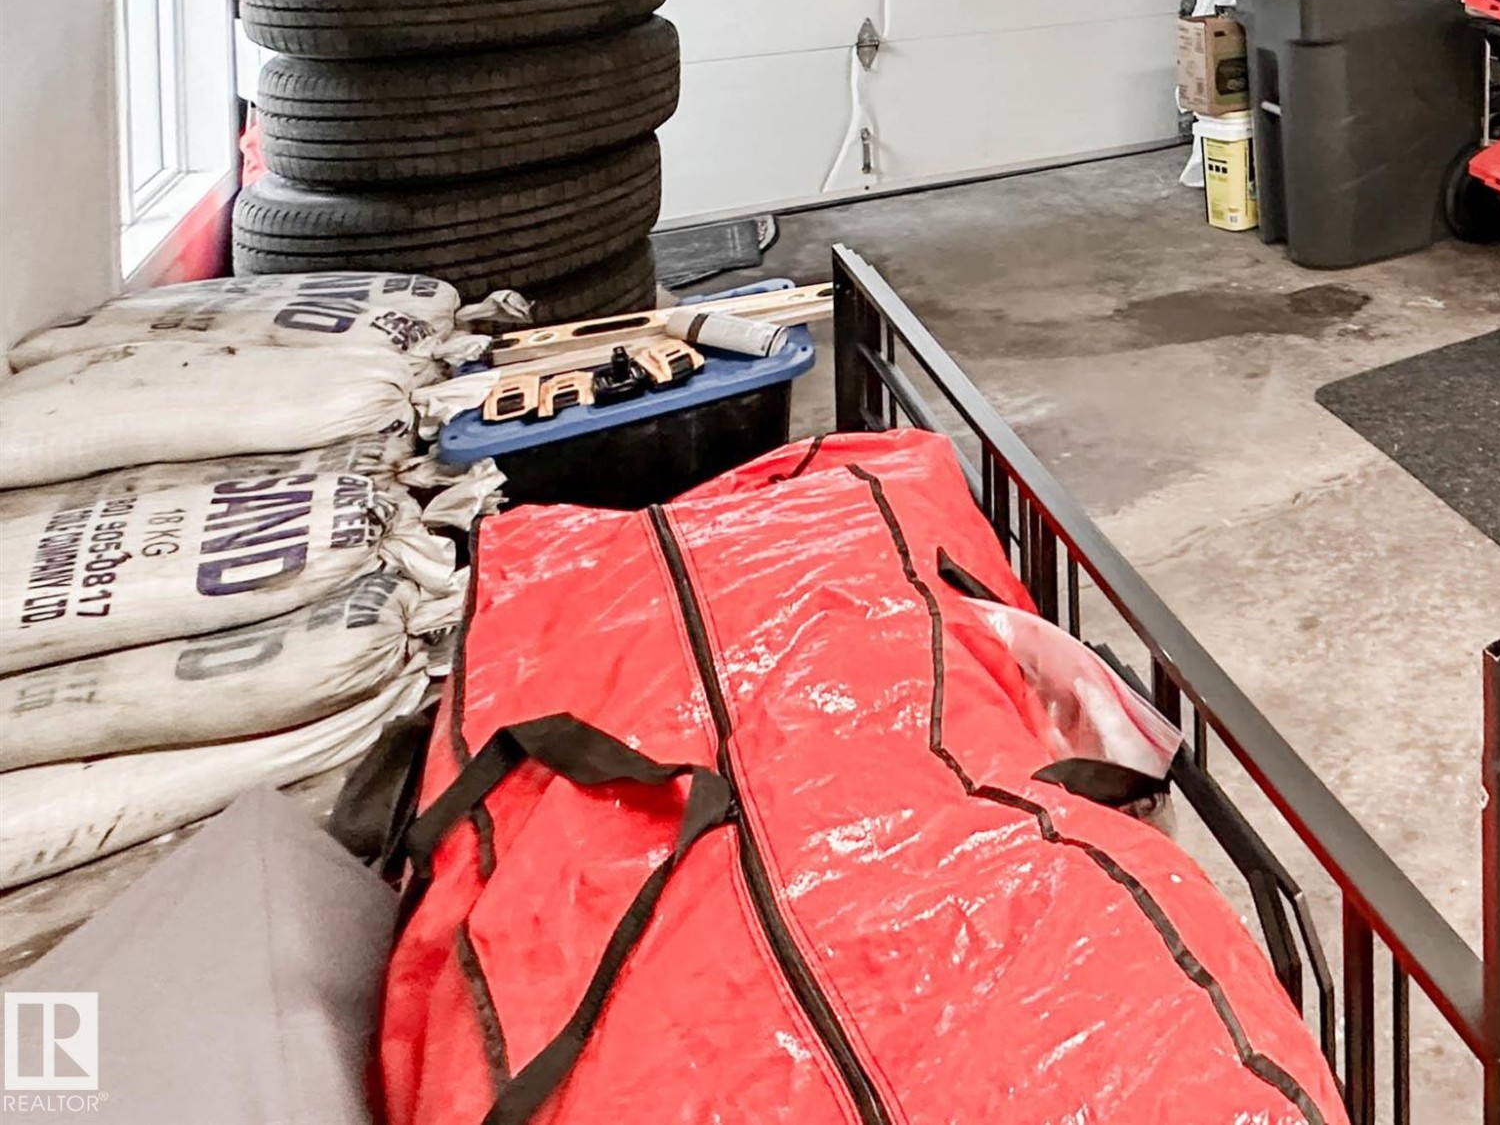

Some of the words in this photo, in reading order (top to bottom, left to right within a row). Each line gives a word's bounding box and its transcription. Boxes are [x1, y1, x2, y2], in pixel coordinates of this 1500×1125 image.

[147, 508, 187, 526] 18
[196, 473, 319, 597] SAND
[28, 531, 84, 590] COMPANY
[141, 529, 184, 558] KG
